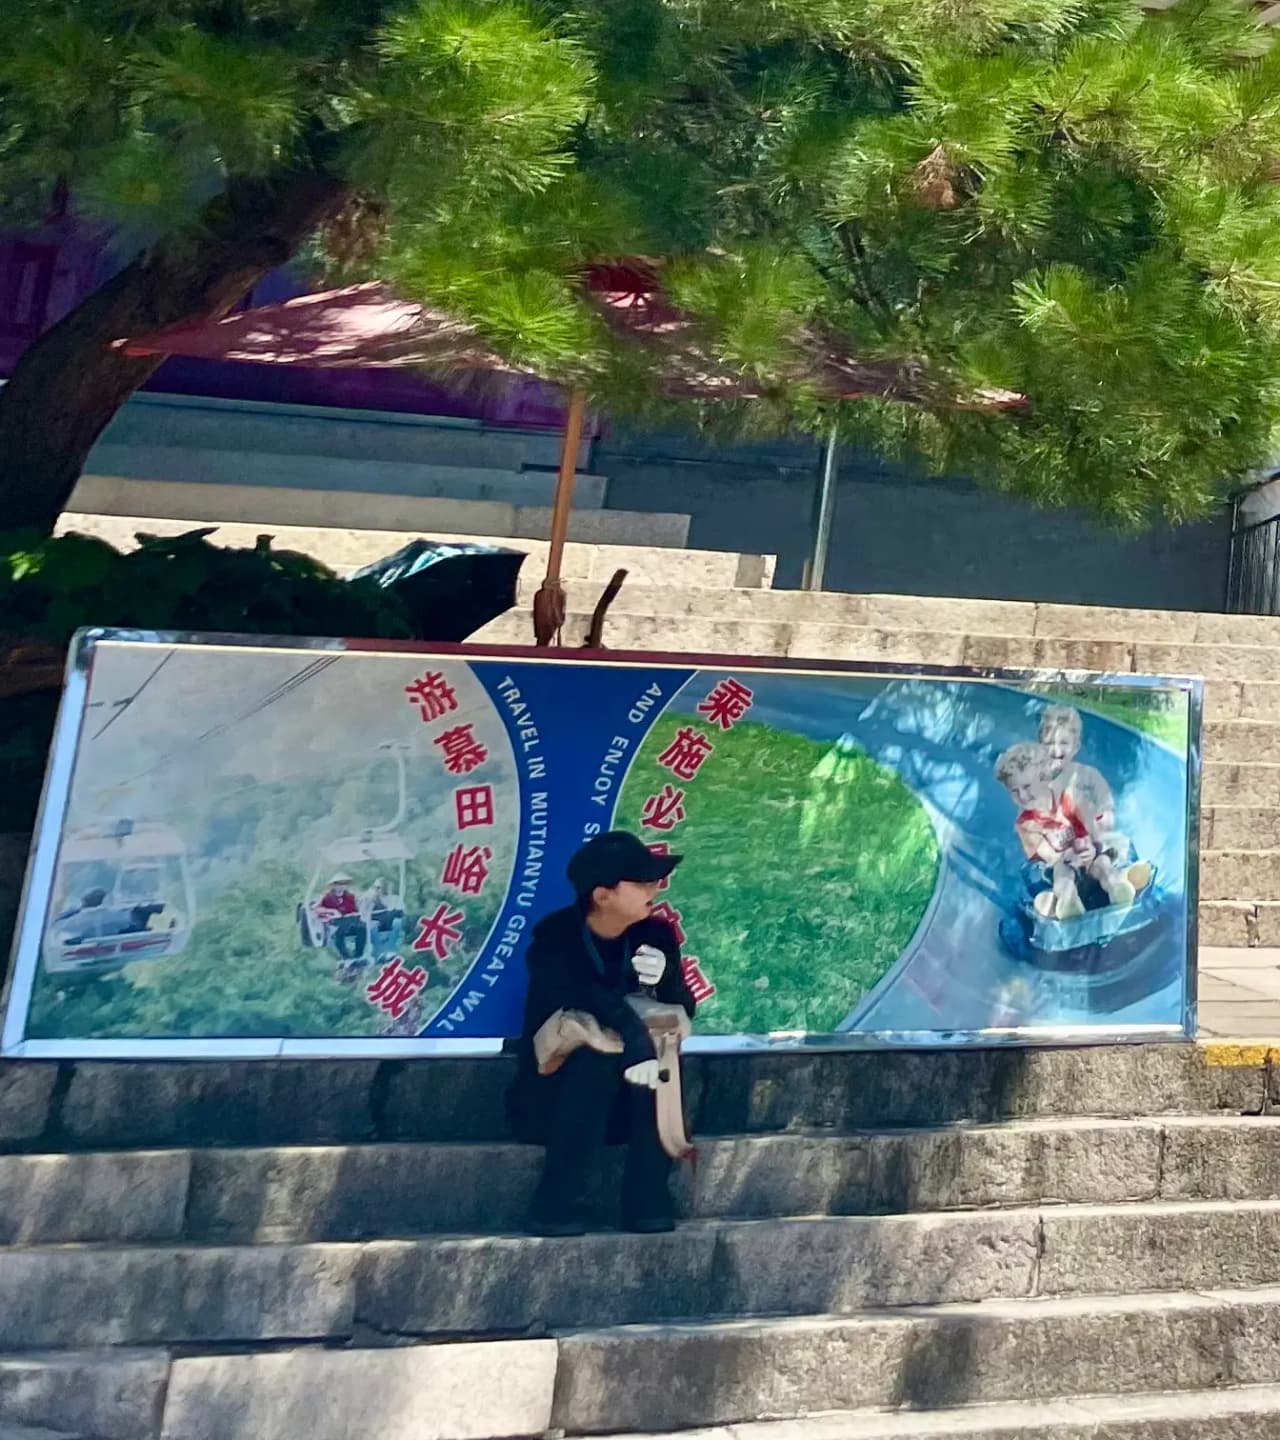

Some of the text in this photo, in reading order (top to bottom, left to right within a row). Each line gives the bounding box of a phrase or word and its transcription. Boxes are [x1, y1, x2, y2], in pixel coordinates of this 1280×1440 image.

[497, 676, 541, 752] TRAVEL
[627, 682, 663, 724] AND
[527, 756, 547, 779] IN
[590, 735, 631, 806] ENJOY
[367, 670, 494, 1020] 游慕田峪长城
[516, 791, 549, 908] MUTIANYU
[480, 914, 527, 988] GREAT
